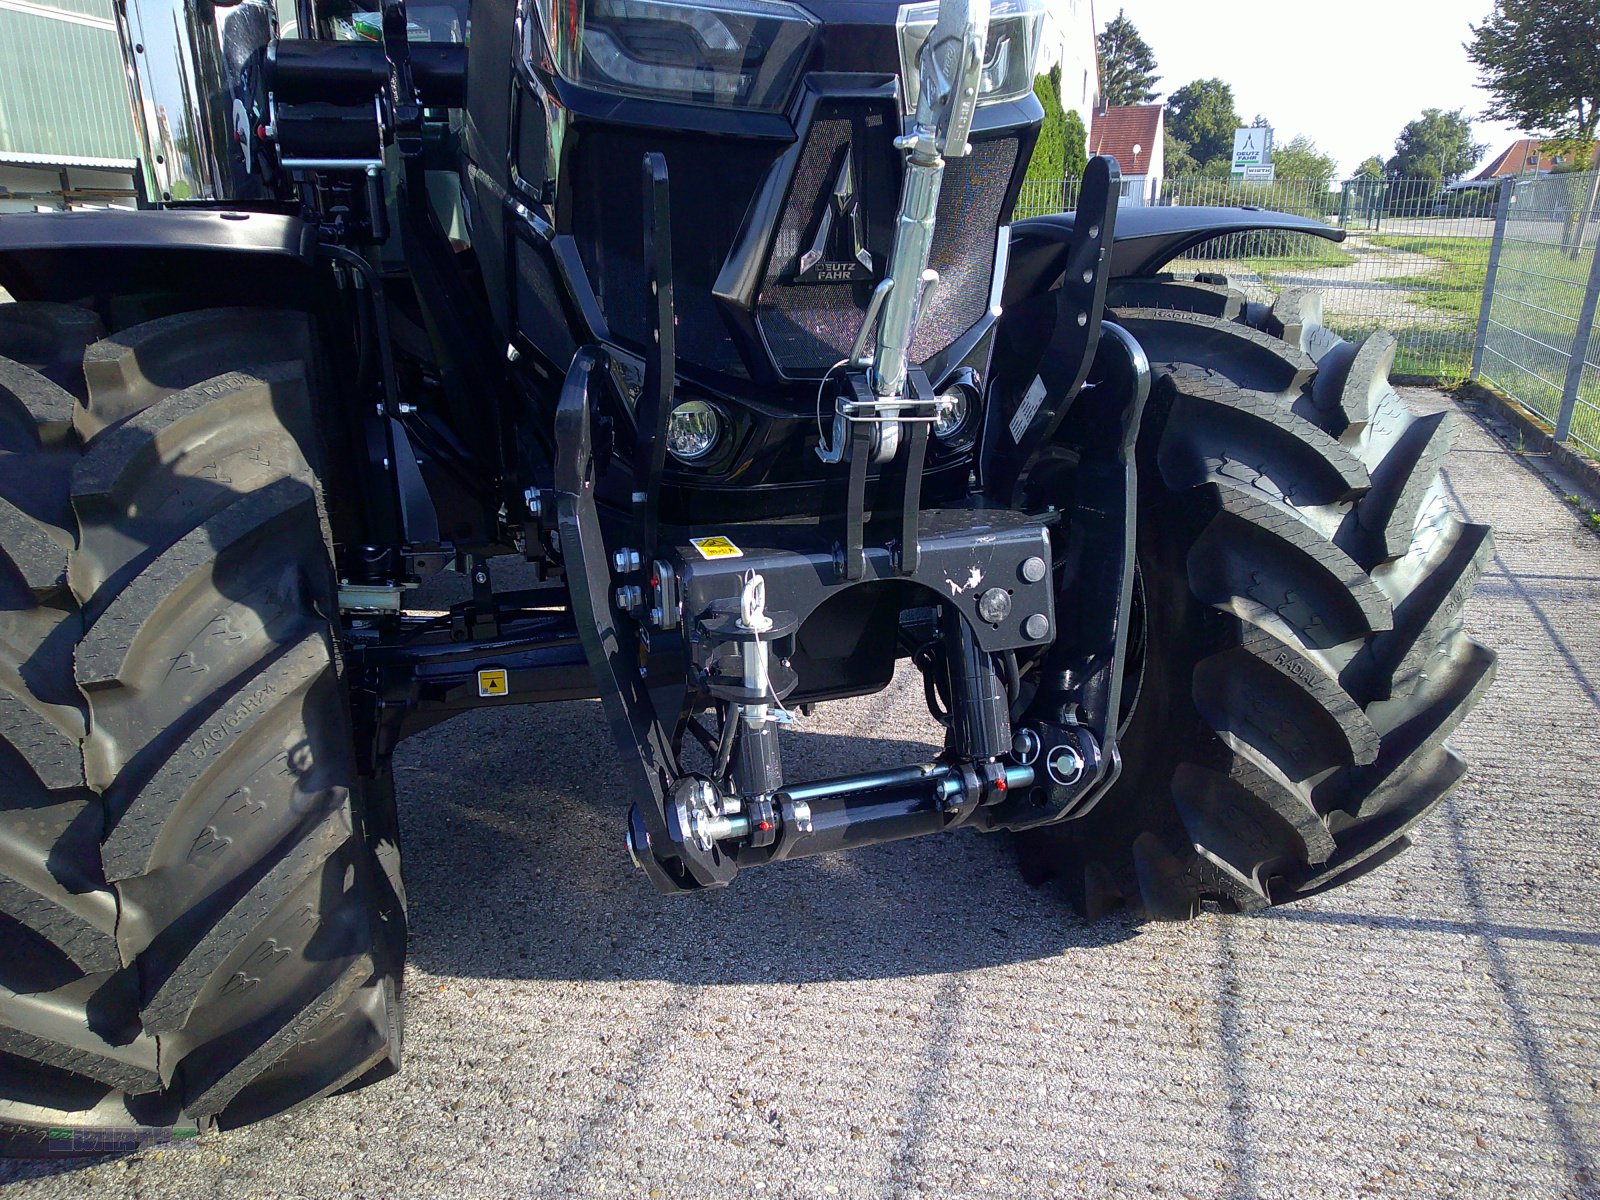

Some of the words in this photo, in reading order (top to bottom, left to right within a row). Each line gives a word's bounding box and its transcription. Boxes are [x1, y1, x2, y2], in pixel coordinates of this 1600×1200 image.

[815, 263, 856, 272] DEUTZ
[817, 271, 852, 280] FAHR
[1274, 652, 1318, 687] RADIAL
